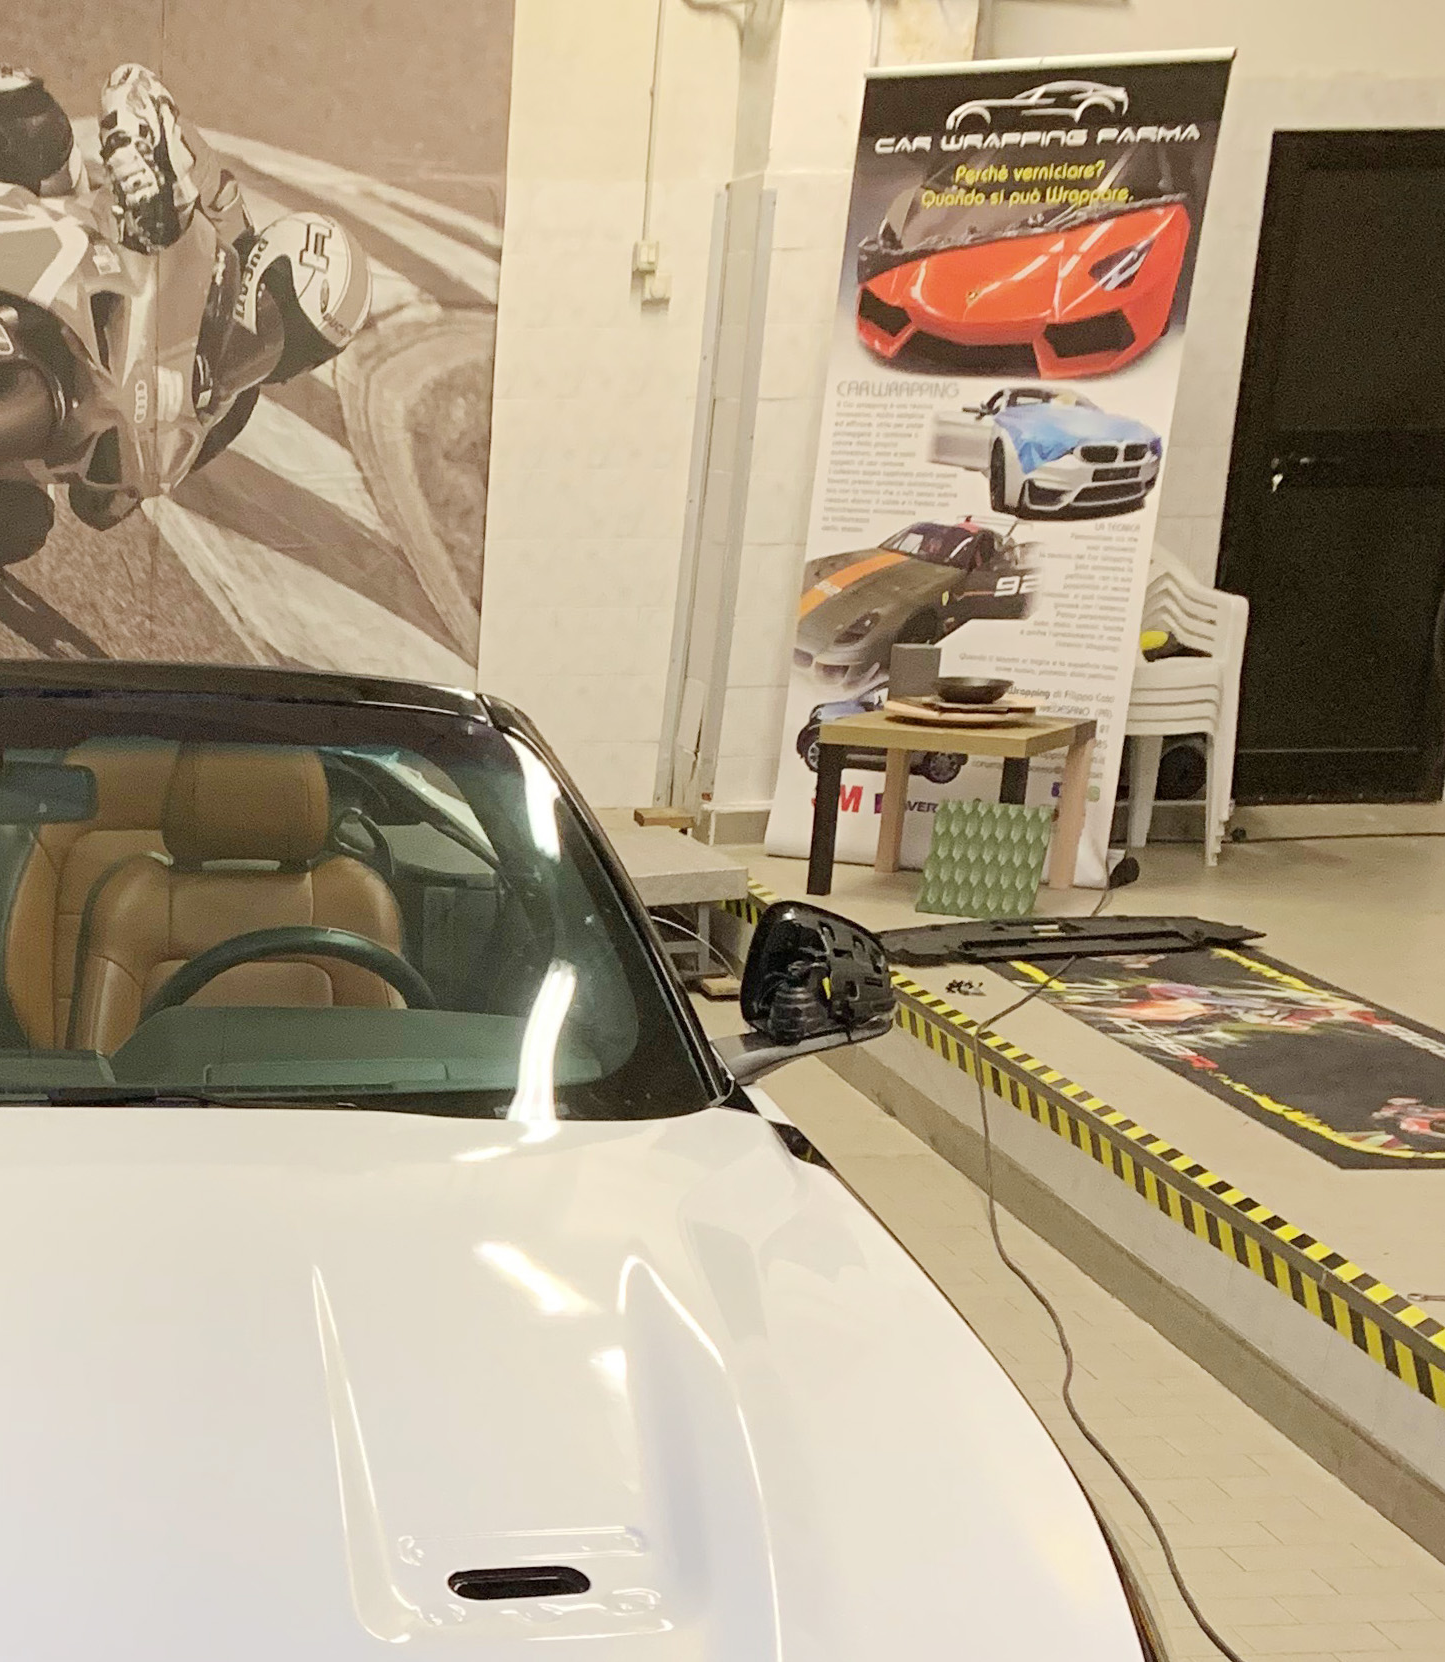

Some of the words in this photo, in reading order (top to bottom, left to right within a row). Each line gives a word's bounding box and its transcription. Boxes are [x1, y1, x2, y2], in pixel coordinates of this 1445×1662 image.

[875, 136, 932, 154] CAR
[941, 129, 1088, 152] WRAPPING
[1096, 123, 1201, 145] PARMA
[955, 164, 1009, 187] Perché
[1013, 159, 1106, 184] verniciare?
[921, 187, 986, 209] Quando
[990, 188, 1006, 206] si
